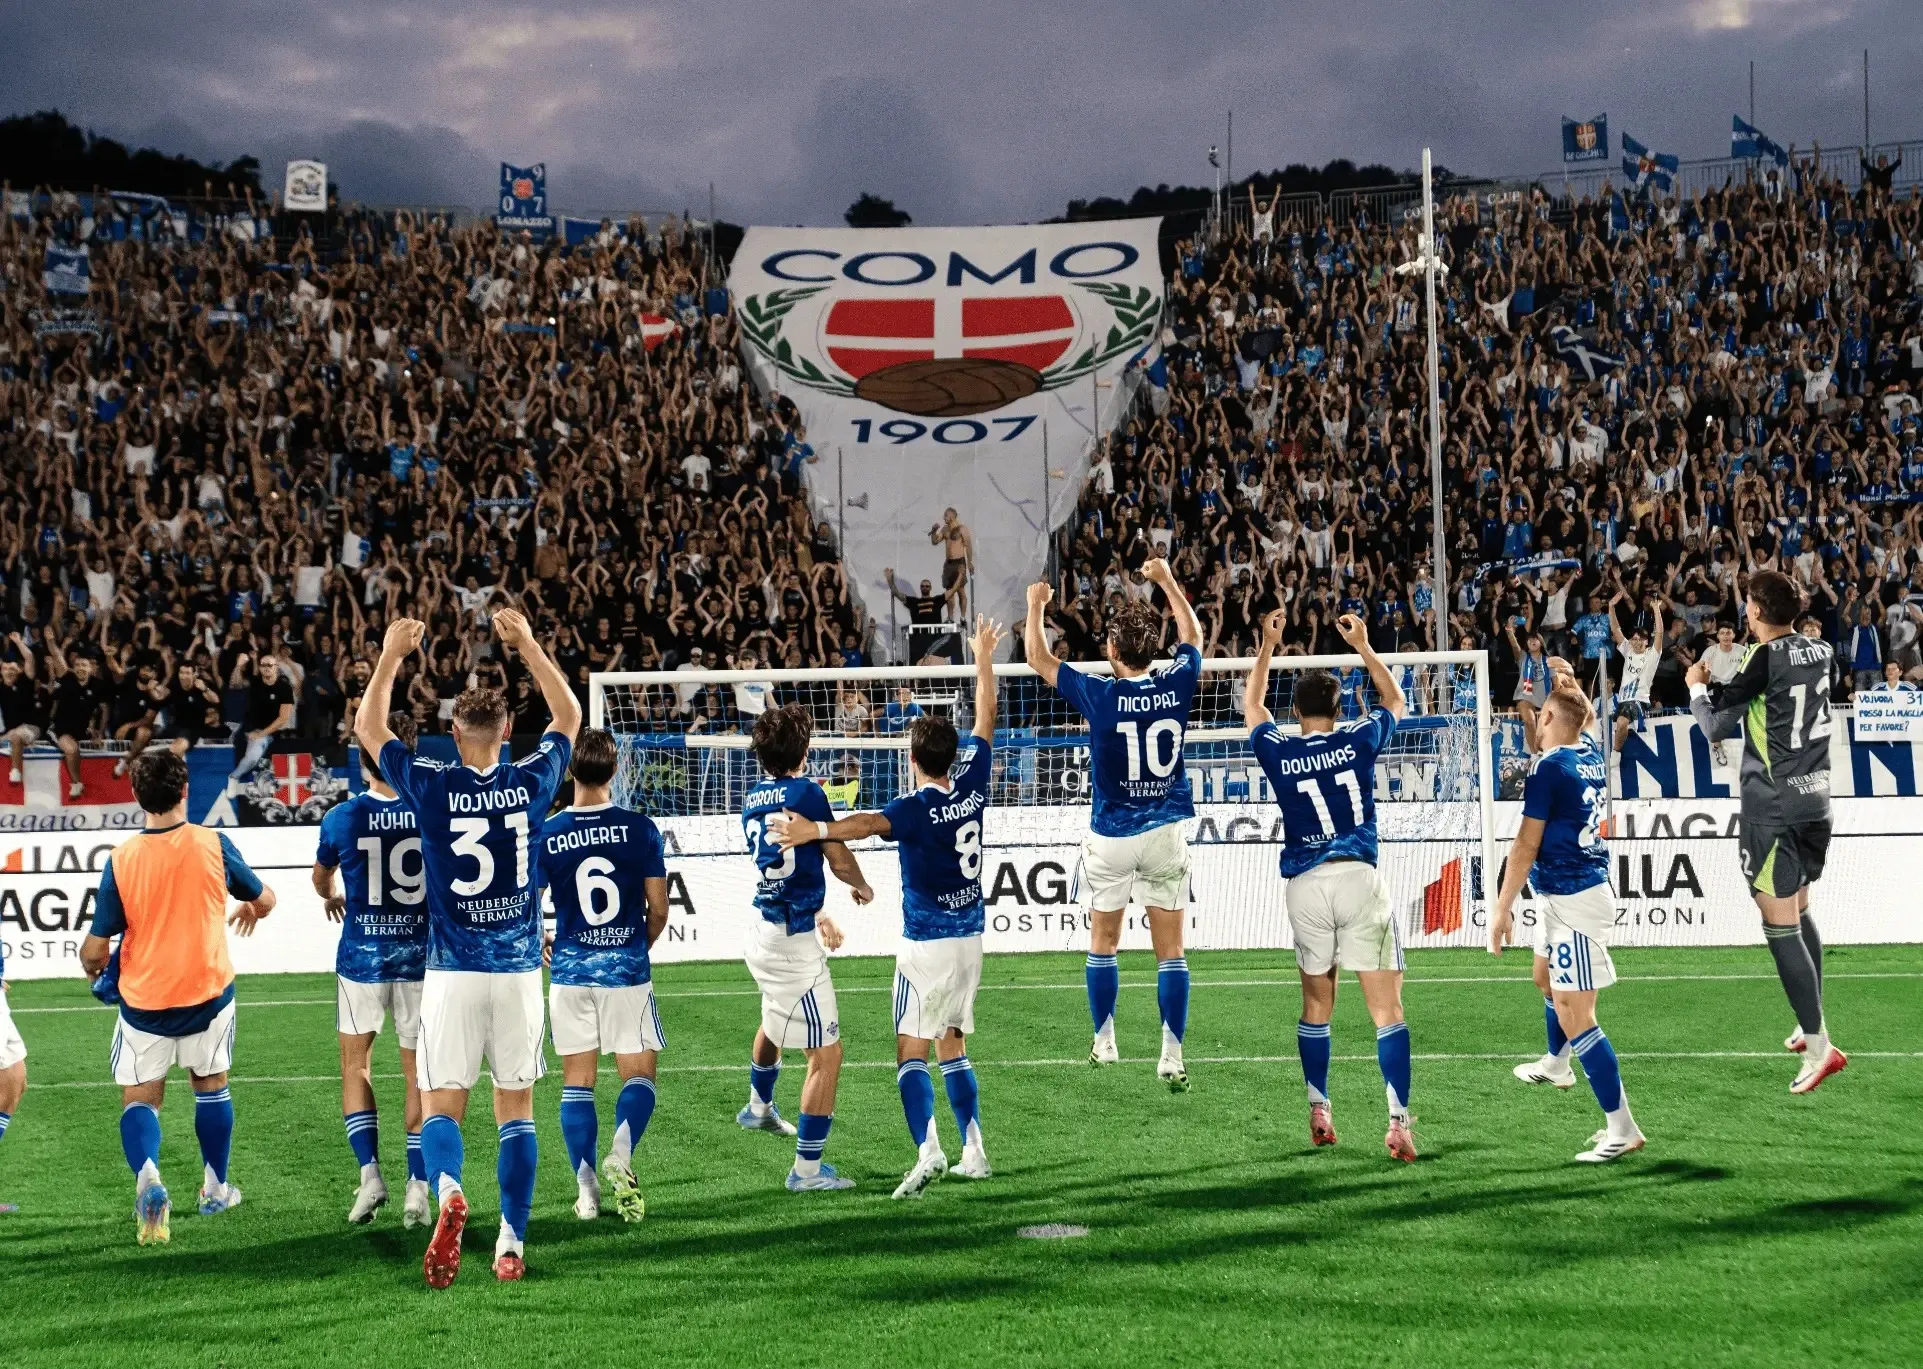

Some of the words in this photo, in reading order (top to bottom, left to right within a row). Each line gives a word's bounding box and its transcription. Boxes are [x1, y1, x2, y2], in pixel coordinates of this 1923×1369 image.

[761, 241, 1139, 287] COMO
[850, 416, 1039, 444] 1907
[1118, 696, 1151, 712] NICO
[1153, 691, 1180, 711] PAZ
[1789, 675, 1832, 749] 12
[1907, 692, 1923, 705] 31
[1859, 709, 1883, 718] POSSO
[1886, 709, 1896, 717] LA
[1860, 723, 1872, 731] PER
[1116, 718, 1182, 780] 10
[1281, 744, 1356, 775] DOUVIKAS
[449, 787, 530, 812] VOJVODA
[1297, 769, 1364, 835] 11
[369, 807, 416, 830] KÜHN
[450, 811, 530, 896] 31
[547, 825, 629, 854] CAQUERET
[954, 820, 982, 880] 8
[357, 836, 427, 905] 19
[457, 891, 530, 911] NEUBERGER
[575, 856, 620, 926] 6
[471, 907, 523, 922] BERMAN
[364, 926, 413, 936] BERMAN
